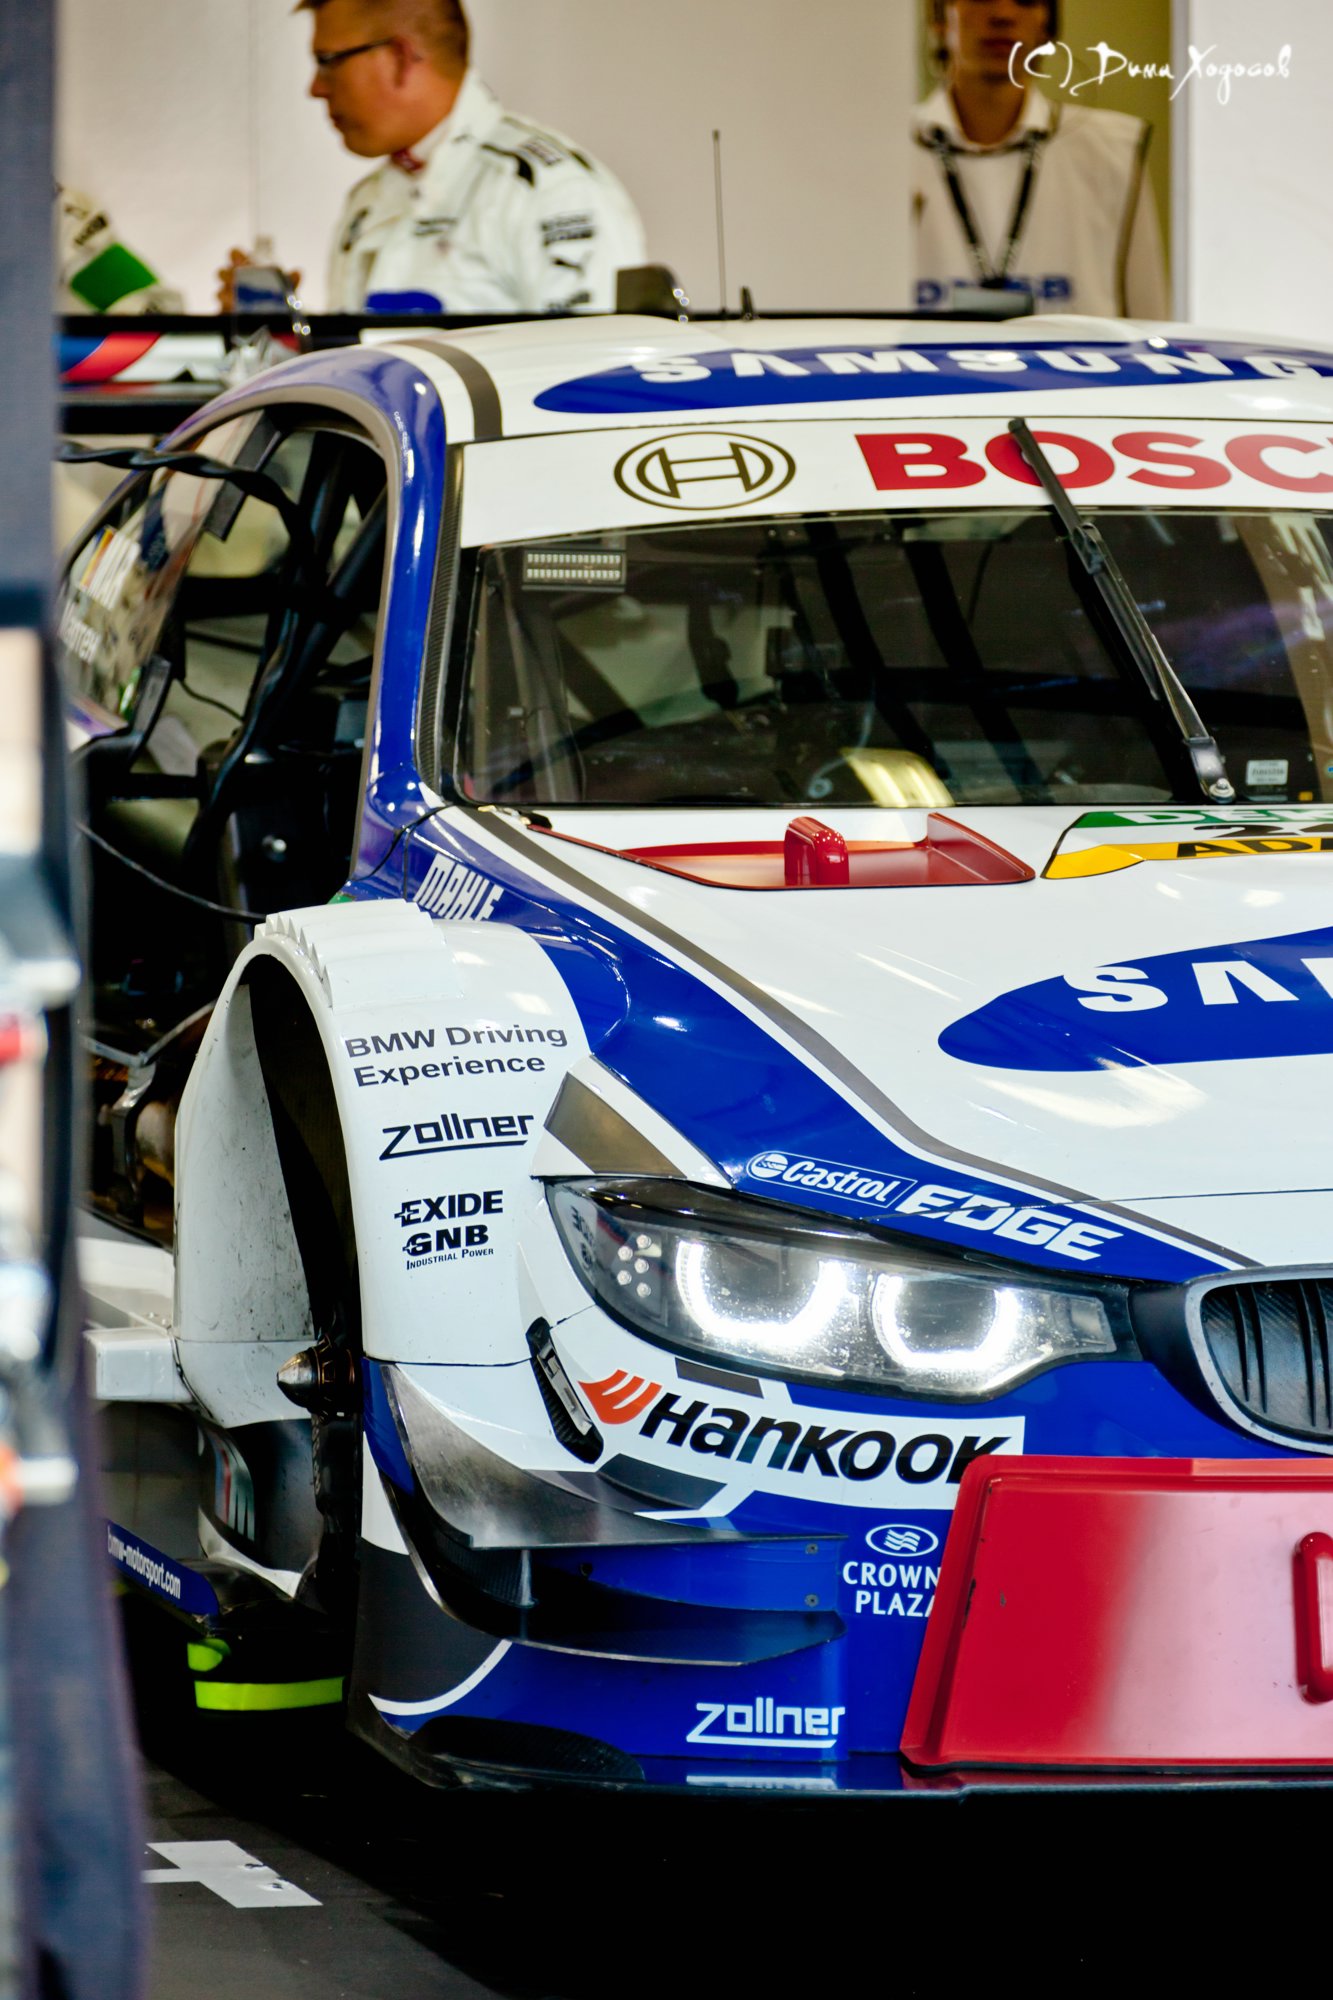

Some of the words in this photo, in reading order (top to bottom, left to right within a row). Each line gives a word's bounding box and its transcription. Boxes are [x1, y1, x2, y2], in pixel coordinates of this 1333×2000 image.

[633, 350, 1324, 383] SAMSUNG
[854, 430, 1333, 493] BOSC
[1176, 837, 1333, 858] AD
[413, 852, 505, 920] MAHLE
[345, 1028, 436, 1058] BMW
[445, 1024, 568, 1047] Driving
[353, 1056, 546, 1087] Experience
[394, 1189, 504, 1228] EXIDE
[782, 1160, 901, 1202] Castrol
[894, 1183, 1124, 1262] EDGE
[402, 1224, 489, 1257] GNB
